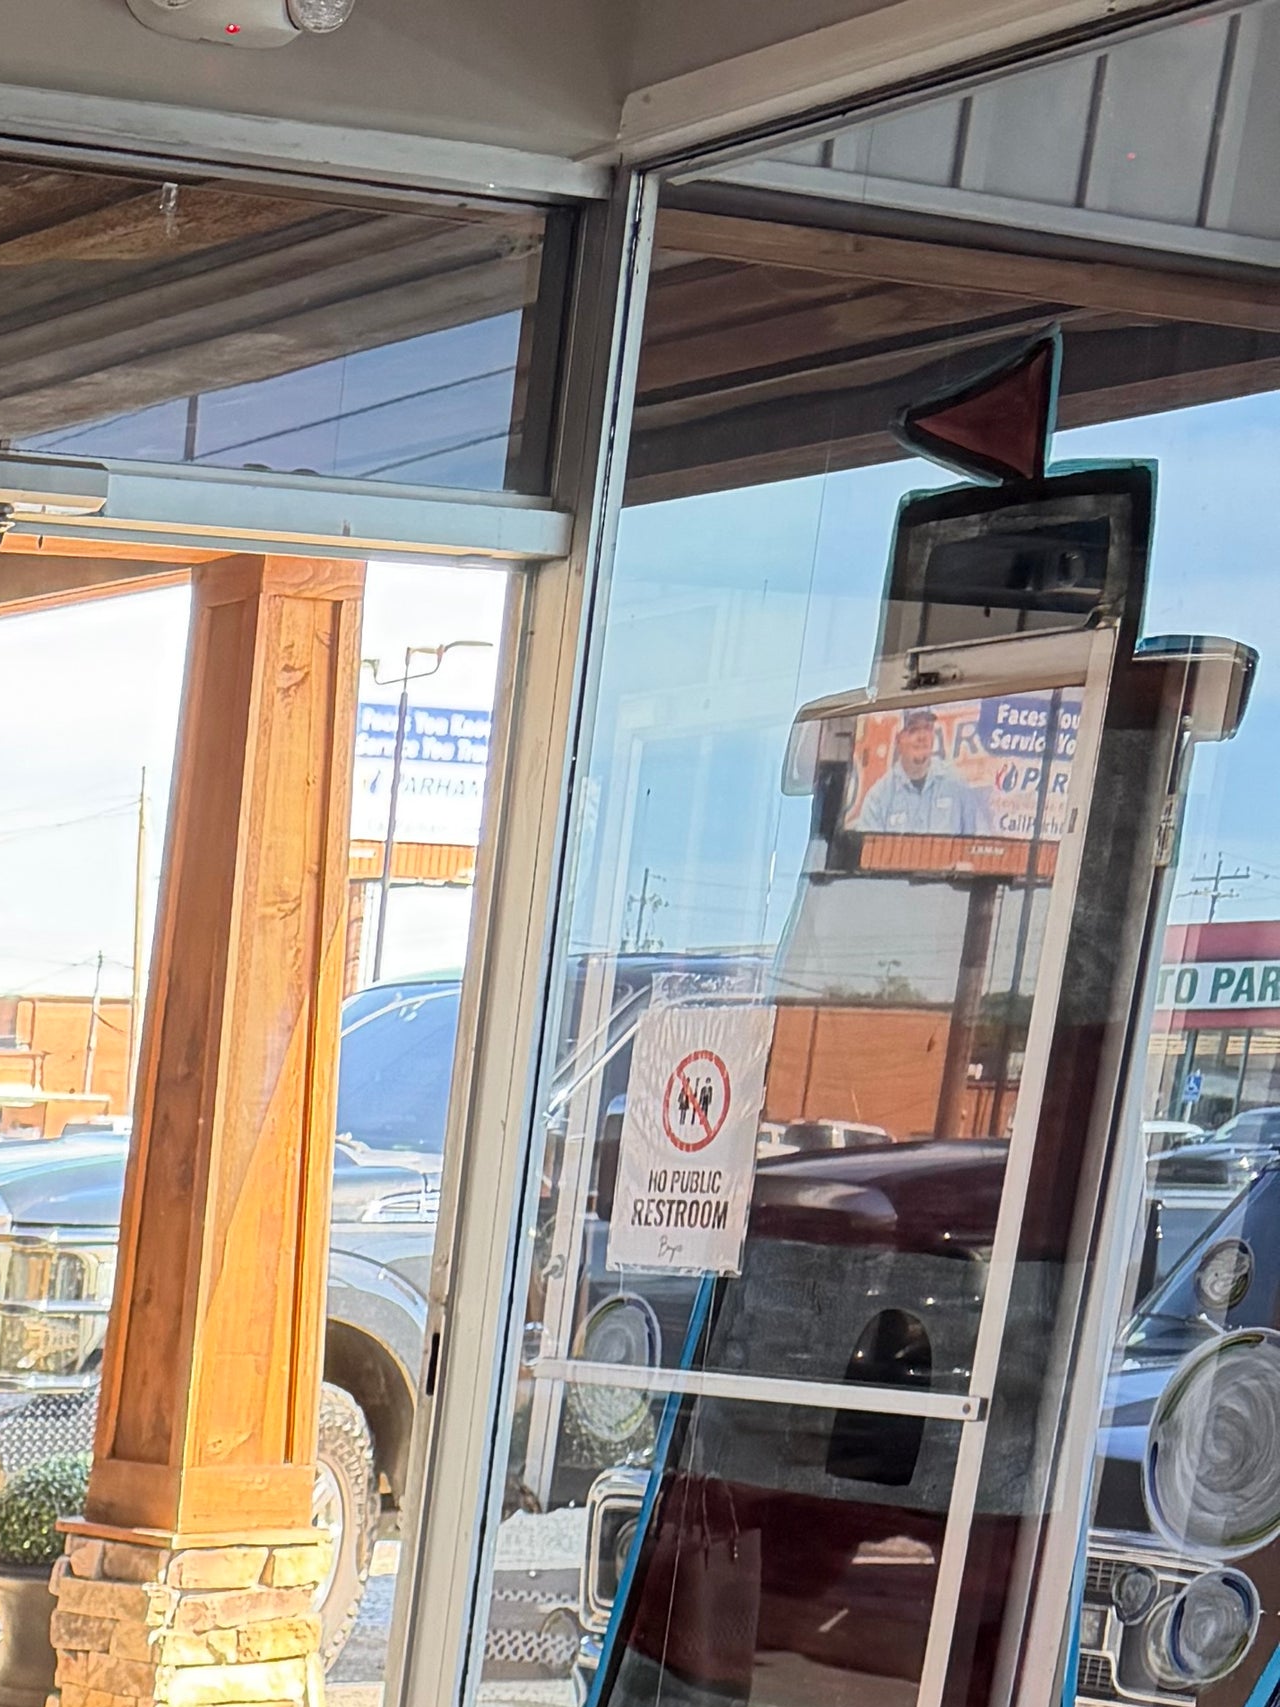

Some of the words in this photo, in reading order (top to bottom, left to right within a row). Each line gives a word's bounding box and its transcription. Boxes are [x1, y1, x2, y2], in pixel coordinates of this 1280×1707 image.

[997, 703, 1048, 728] Faces
[647, 1169, 668, 1194] NO
[670, 1170, 722, 1195] PUBLIC
[631, 1199, 730, 1230] RESTROOM
